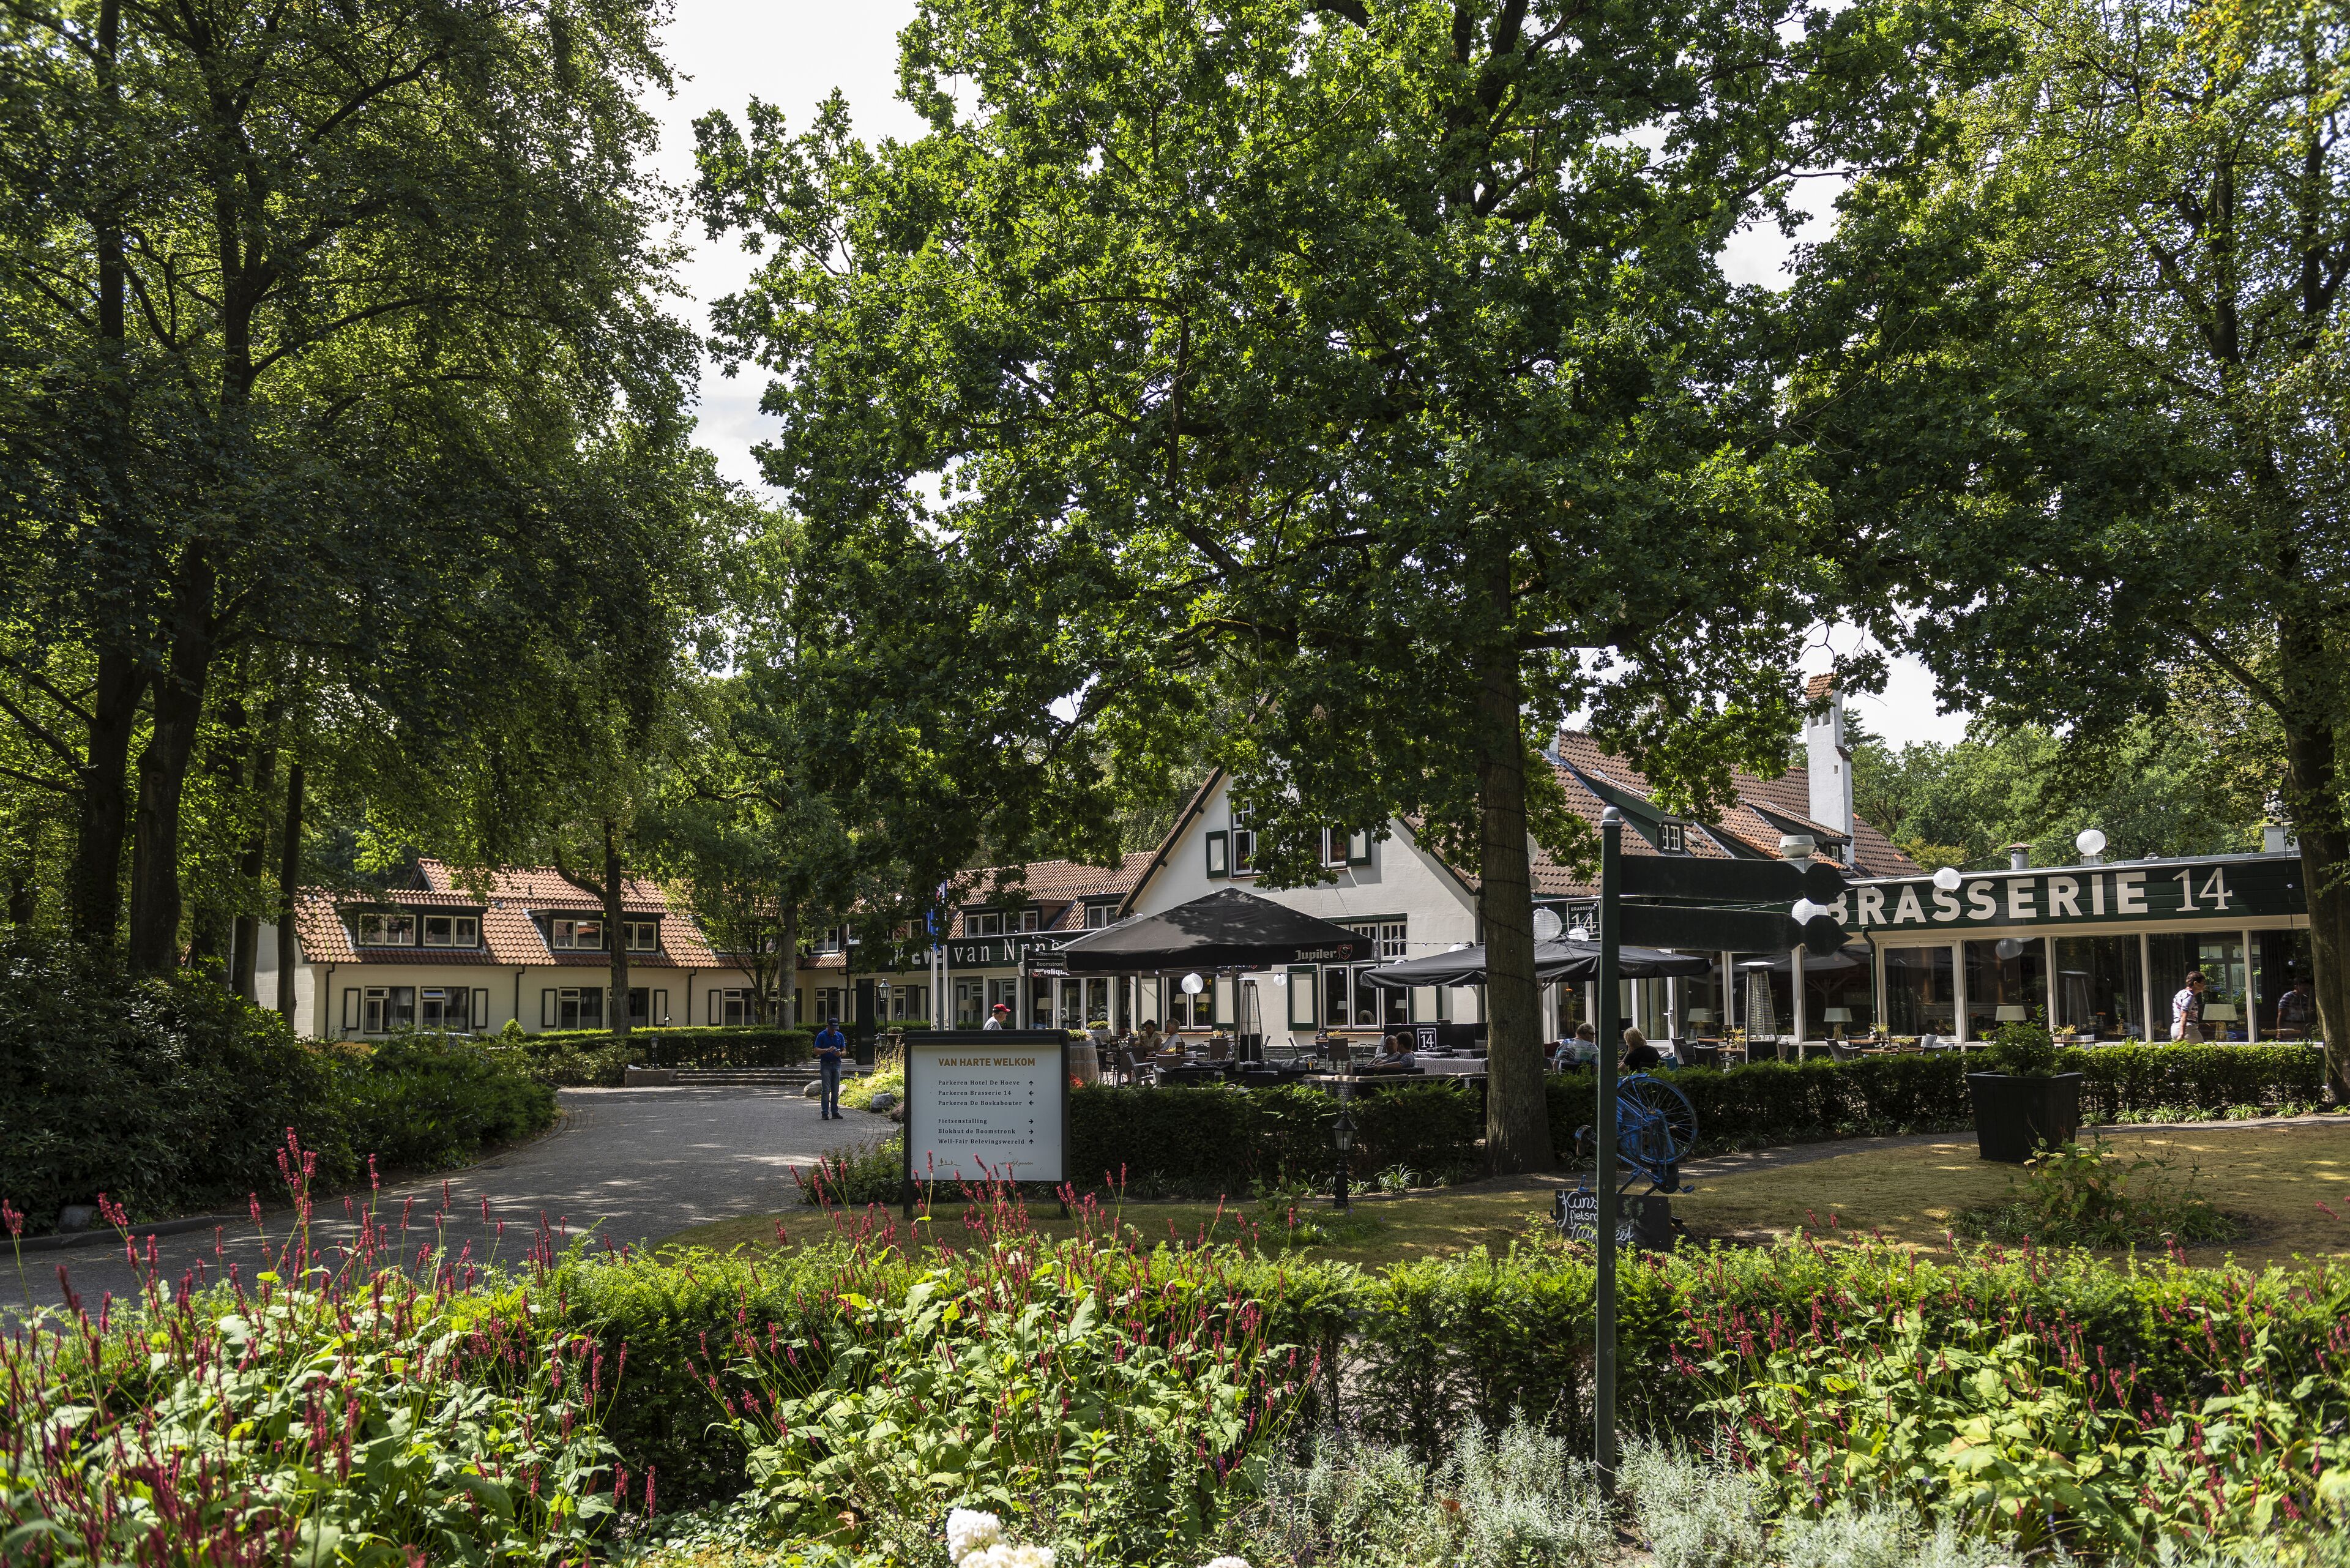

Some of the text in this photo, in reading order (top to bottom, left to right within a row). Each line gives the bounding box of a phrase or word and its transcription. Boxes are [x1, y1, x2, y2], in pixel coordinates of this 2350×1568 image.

[1827, 867, 2232, 925] BRASSERIE 14
[1572, 913, 1596, 935] 14
[954, 946, 991, 963] van
[1294, 949, 1336, 961] Jupiler
[1420, 1034, 1434, 1048] 14
